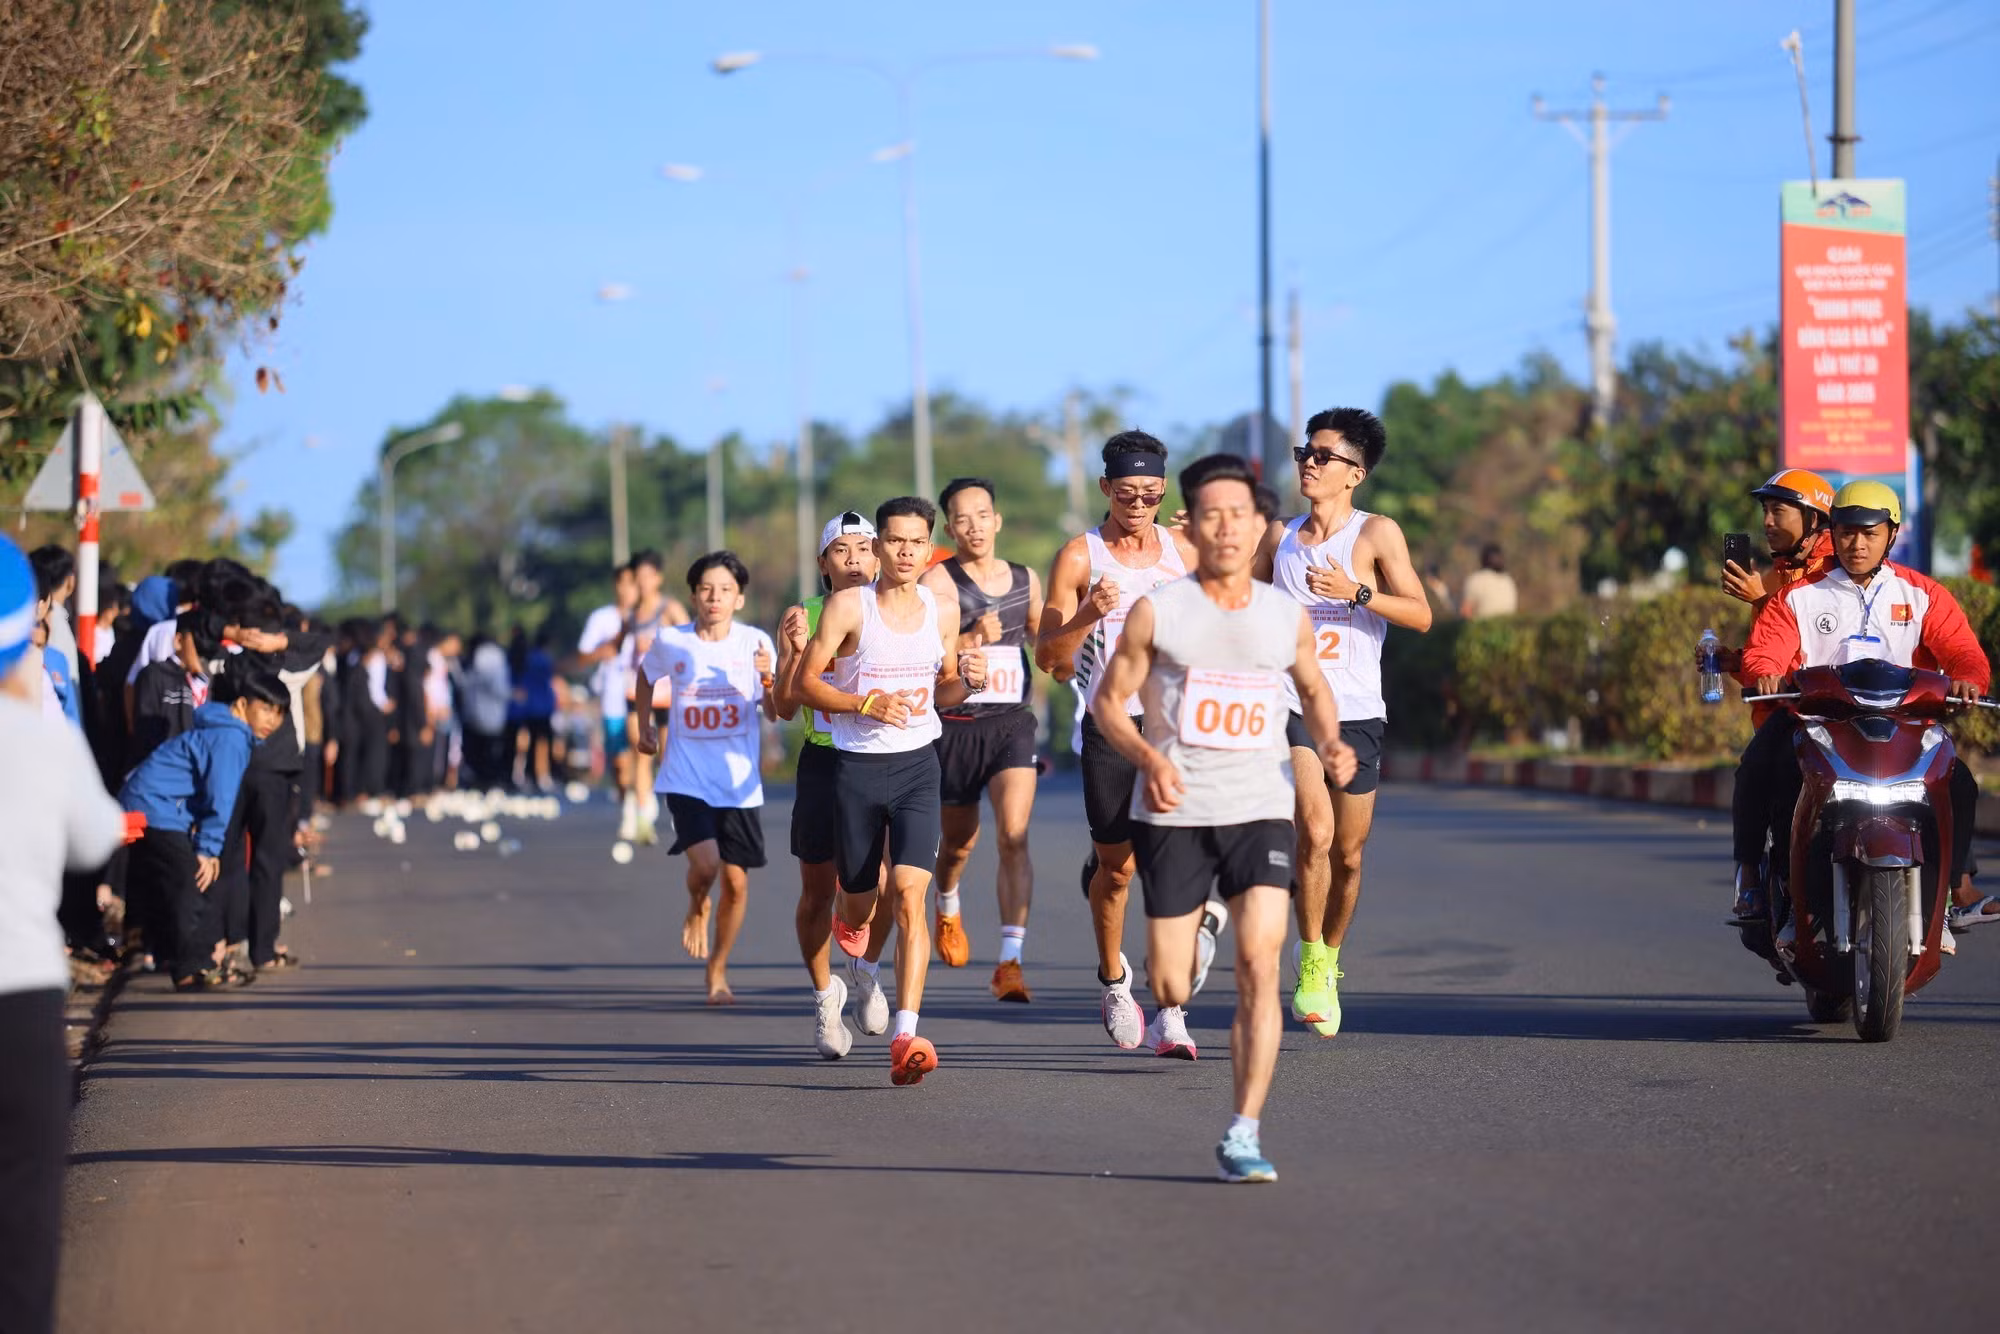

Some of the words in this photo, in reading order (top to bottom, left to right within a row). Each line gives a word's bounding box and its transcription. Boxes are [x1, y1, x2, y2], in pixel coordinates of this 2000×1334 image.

[1315, 631, 1341, 660] 2
[985, 667, 1017, 695] 01
[684, 704, 740, 731] 003
[1196, 699, 1266, 737] 006
